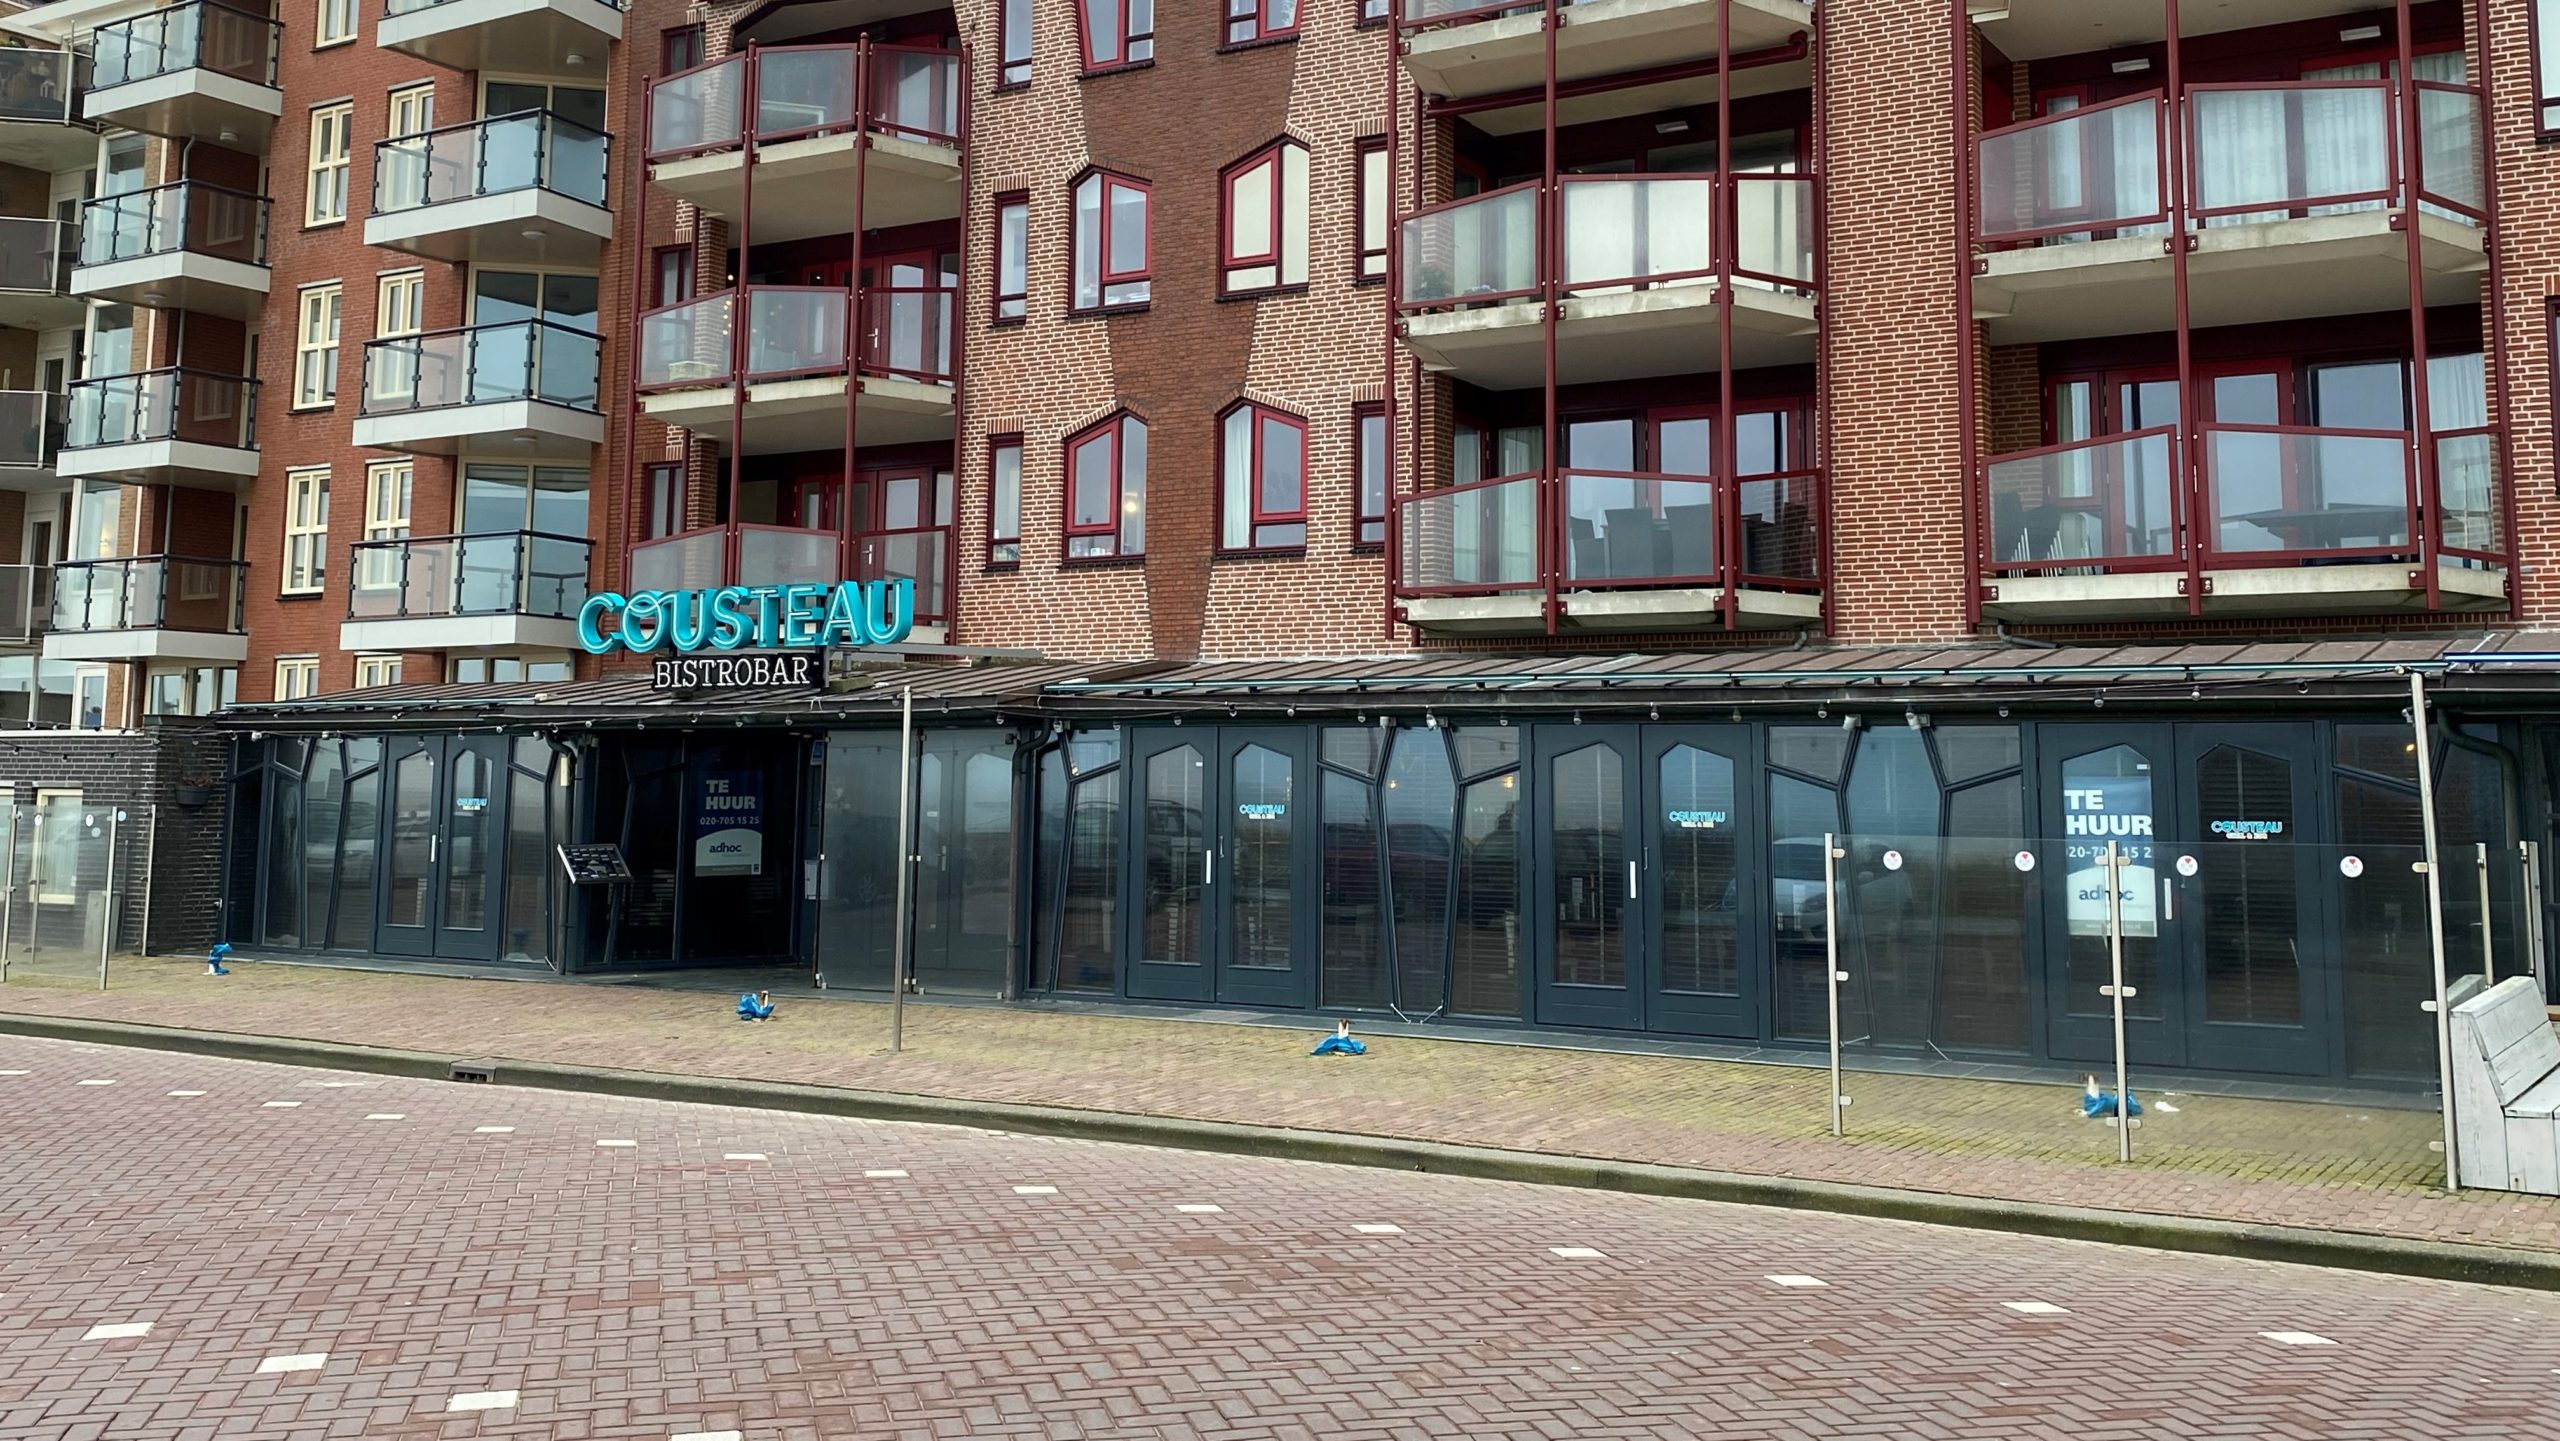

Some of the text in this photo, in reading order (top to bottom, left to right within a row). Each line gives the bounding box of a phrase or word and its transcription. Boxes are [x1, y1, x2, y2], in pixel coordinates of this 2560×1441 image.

[576, 578, 916, 654] COUSTEAU
[654, 657, 811, 690] BISTROBAR
[706, 779, 729, 793] TE
[705, 796, 756, 810] HUUR
[2064, 789, 2104, 810] TE
[700, 816, 760, 825] 020-705 15 25
[2066, 815, 2153, 836] HUUR
[2211, 820, 2283, 833] COUSTEAU
[709, 842, 742, 853] adhoc
[2066, 846, 2108, 858] 20-70
[2122, 846, 2139, 859] 15
